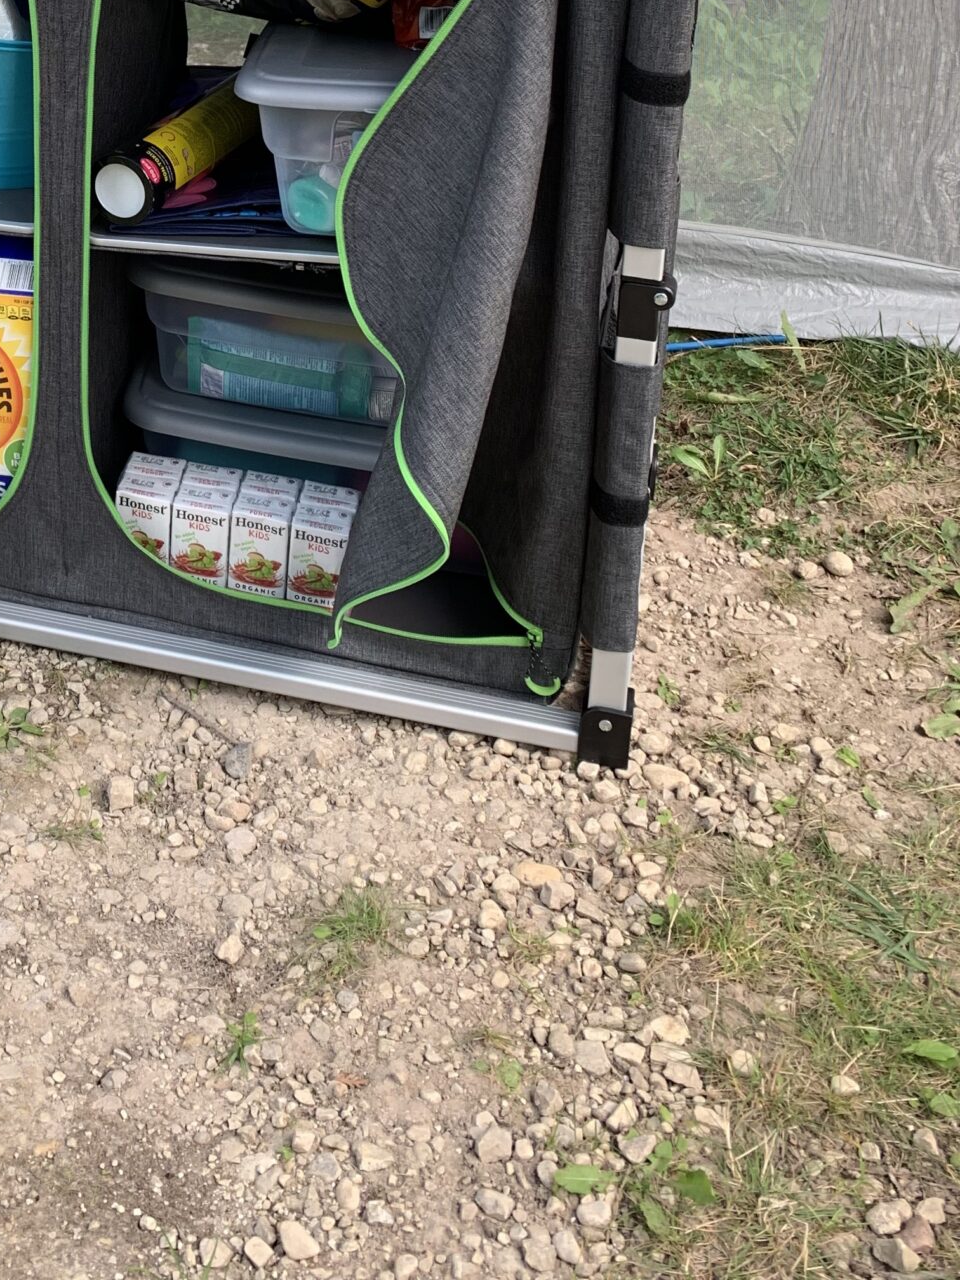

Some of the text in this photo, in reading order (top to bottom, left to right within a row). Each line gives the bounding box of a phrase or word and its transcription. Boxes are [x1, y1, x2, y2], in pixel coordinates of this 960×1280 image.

[119, 496, 168, 515] Honest
[176, 509, 226, 527] Honest
[235, 516, 286, 536] Honest
[295, 528, 348, 548] Honest
[234, 582, 276, 596] ORGANIC
